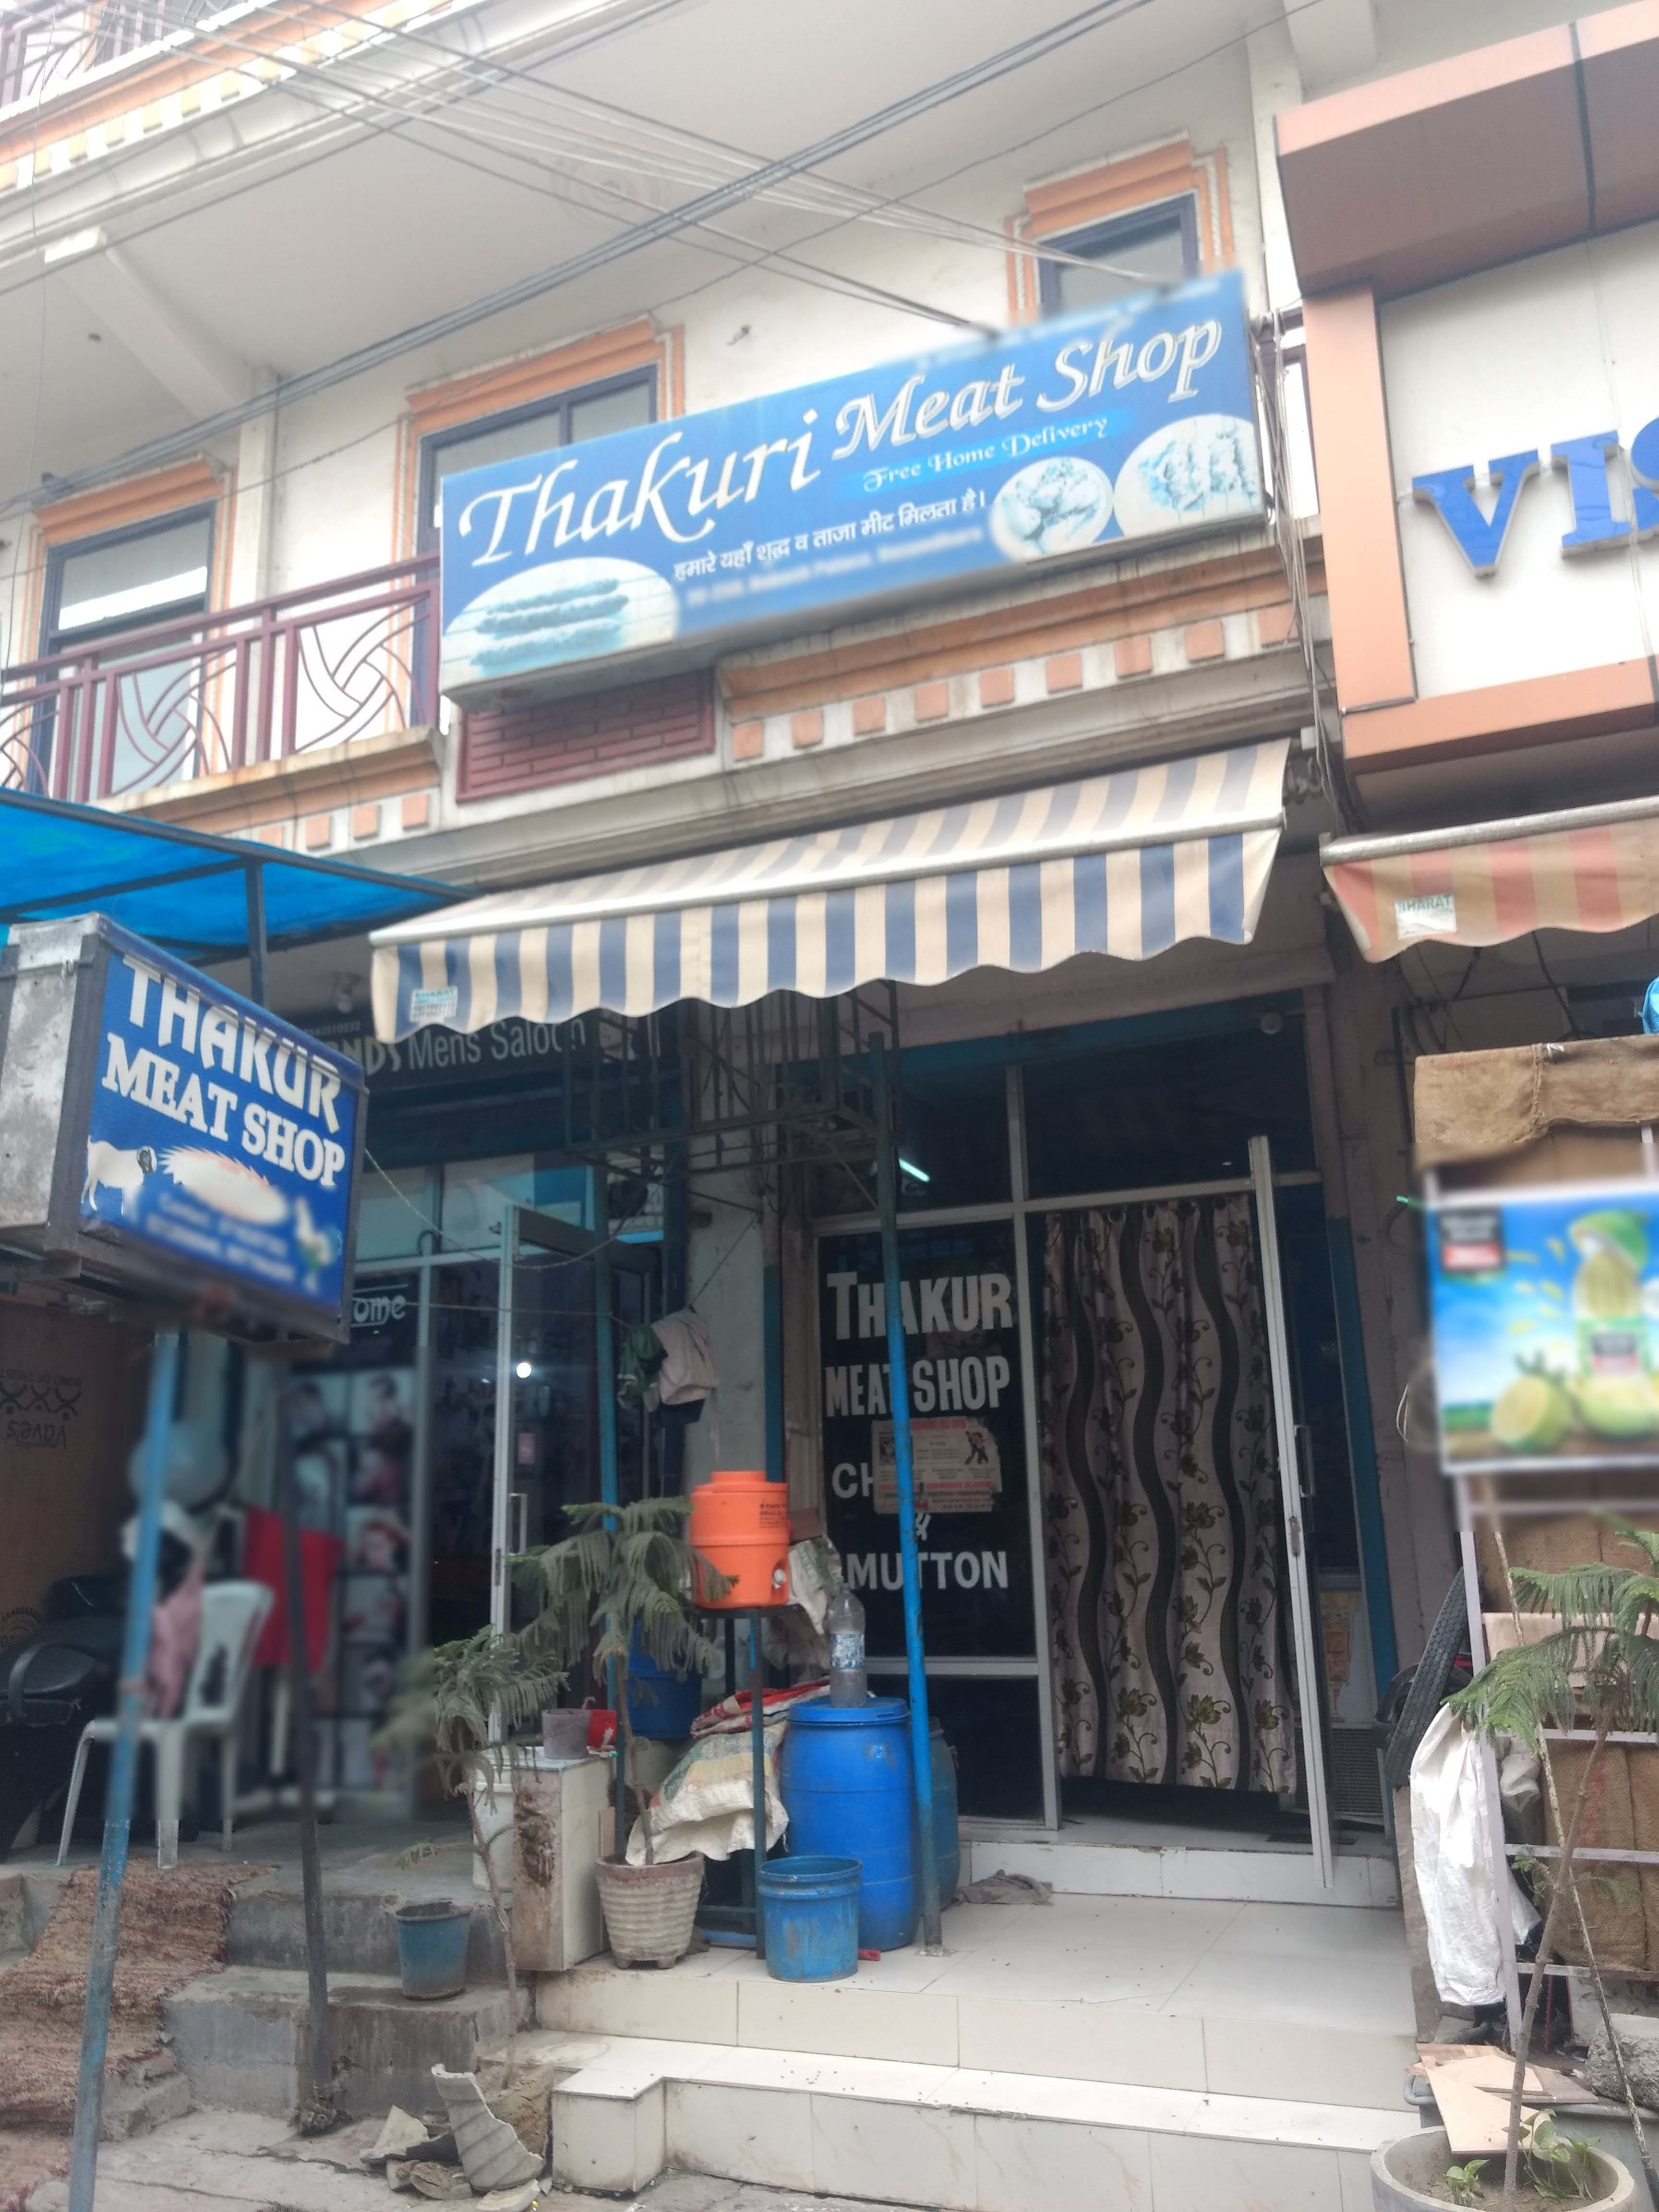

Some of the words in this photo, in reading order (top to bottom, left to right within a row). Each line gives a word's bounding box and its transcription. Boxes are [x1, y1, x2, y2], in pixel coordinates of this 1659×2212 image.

[457, 407, 822, 567] Thakuri
[830, 358, 1026, 459] Meat
[1034, 316, 1223, 414] Shop
[863, 466, 922, 493] Free
[926, 445, 996, 473] Home
[1001, 417, 1108, 457] Delivery
[673, 550, 717, 581] हमारे
[794, 531, 809, 553] व
[812, 521, 857, 548] ताजा
[123, 953, 341, 1134] THAKUR
[409, 1030, 481, 1070] Mens
[102, 1032, 238, 1142] MEAT
[241, 1103, 346, 1186] SHOP
[353, 1295, 408, 1322] ome
[826, 1272, 1013, 1340] THAKUR
[913, 1356, 1010, 1412] SHOP
